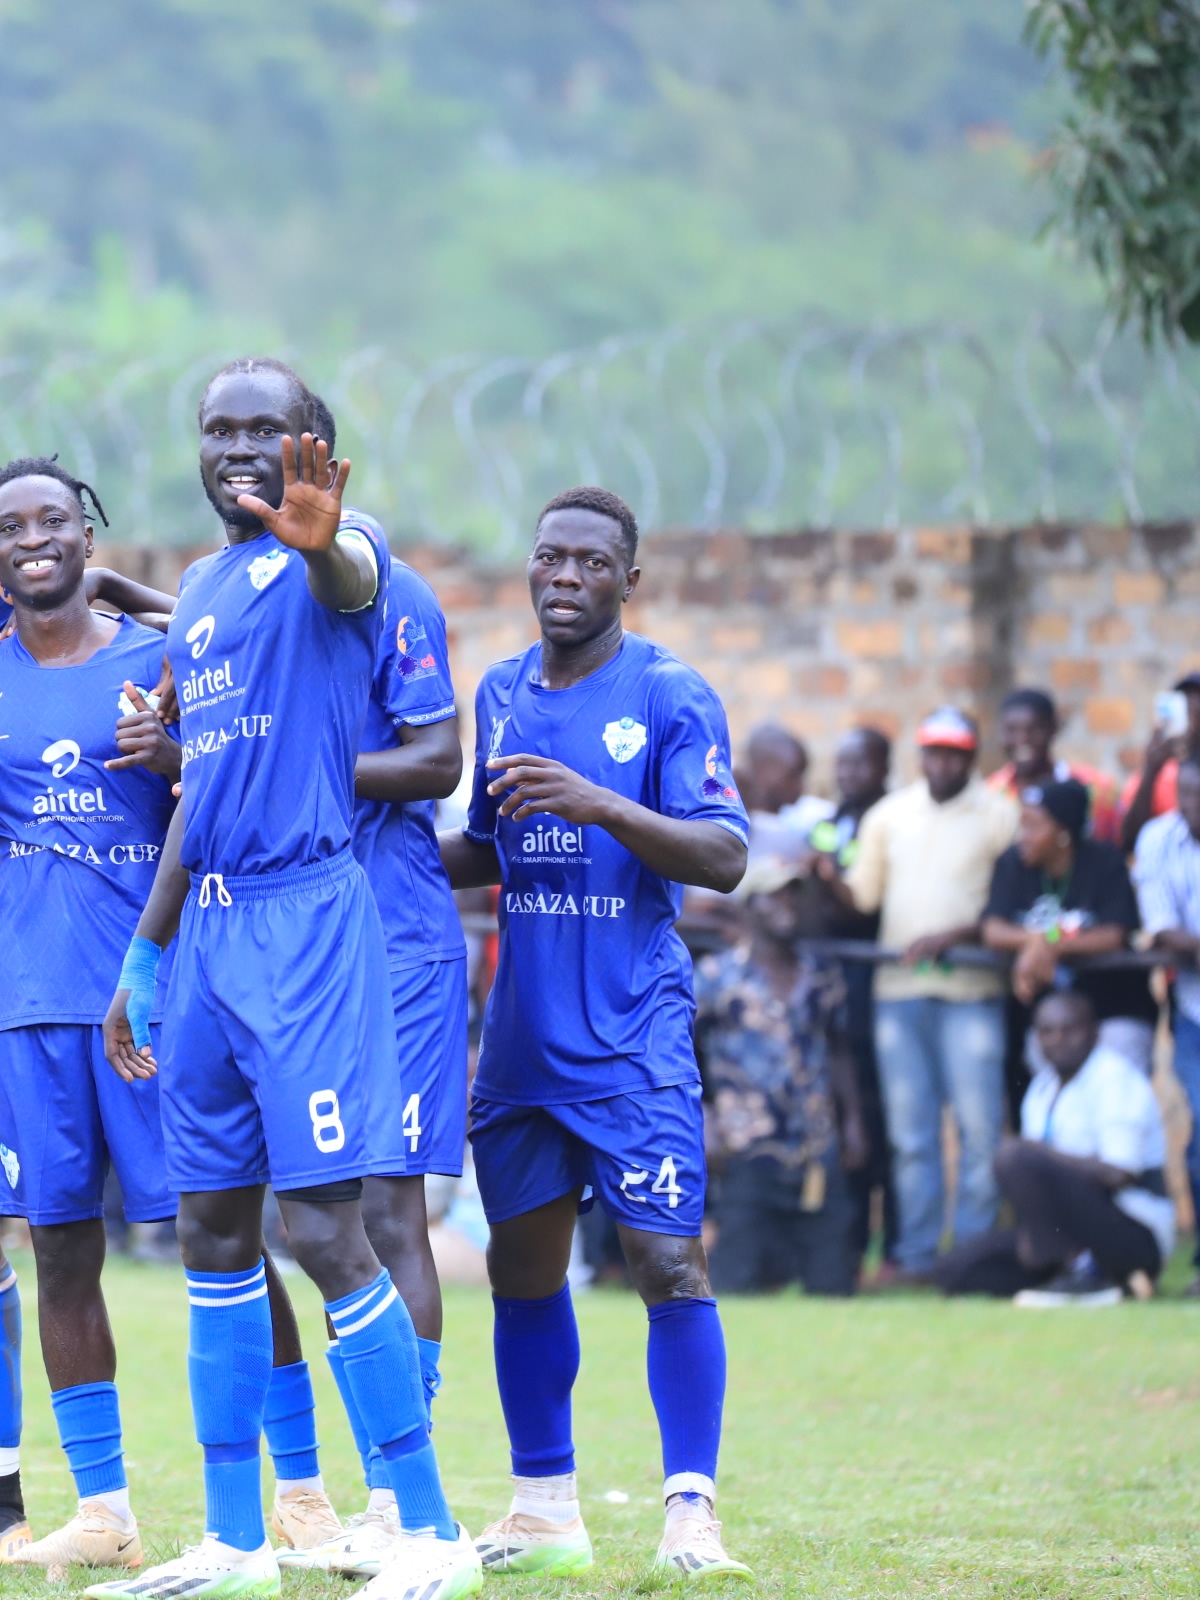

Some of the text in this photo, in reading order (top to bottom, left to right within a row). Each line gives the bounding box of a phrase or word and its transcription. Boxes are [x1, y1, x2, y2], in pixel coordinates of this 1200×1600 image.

[182, 660, 234, 703] airtel
[32, 787, 107, 815] airtel
[24, 815, 125, 829] THE SMARTPHONE NETWORK
[522, 824, 584, 854] airtel
[109, 844, 160, 865] CUP
[522, 856, 567, 864] SMARTPHONE
[309, 1089, 346, 1153] 8
